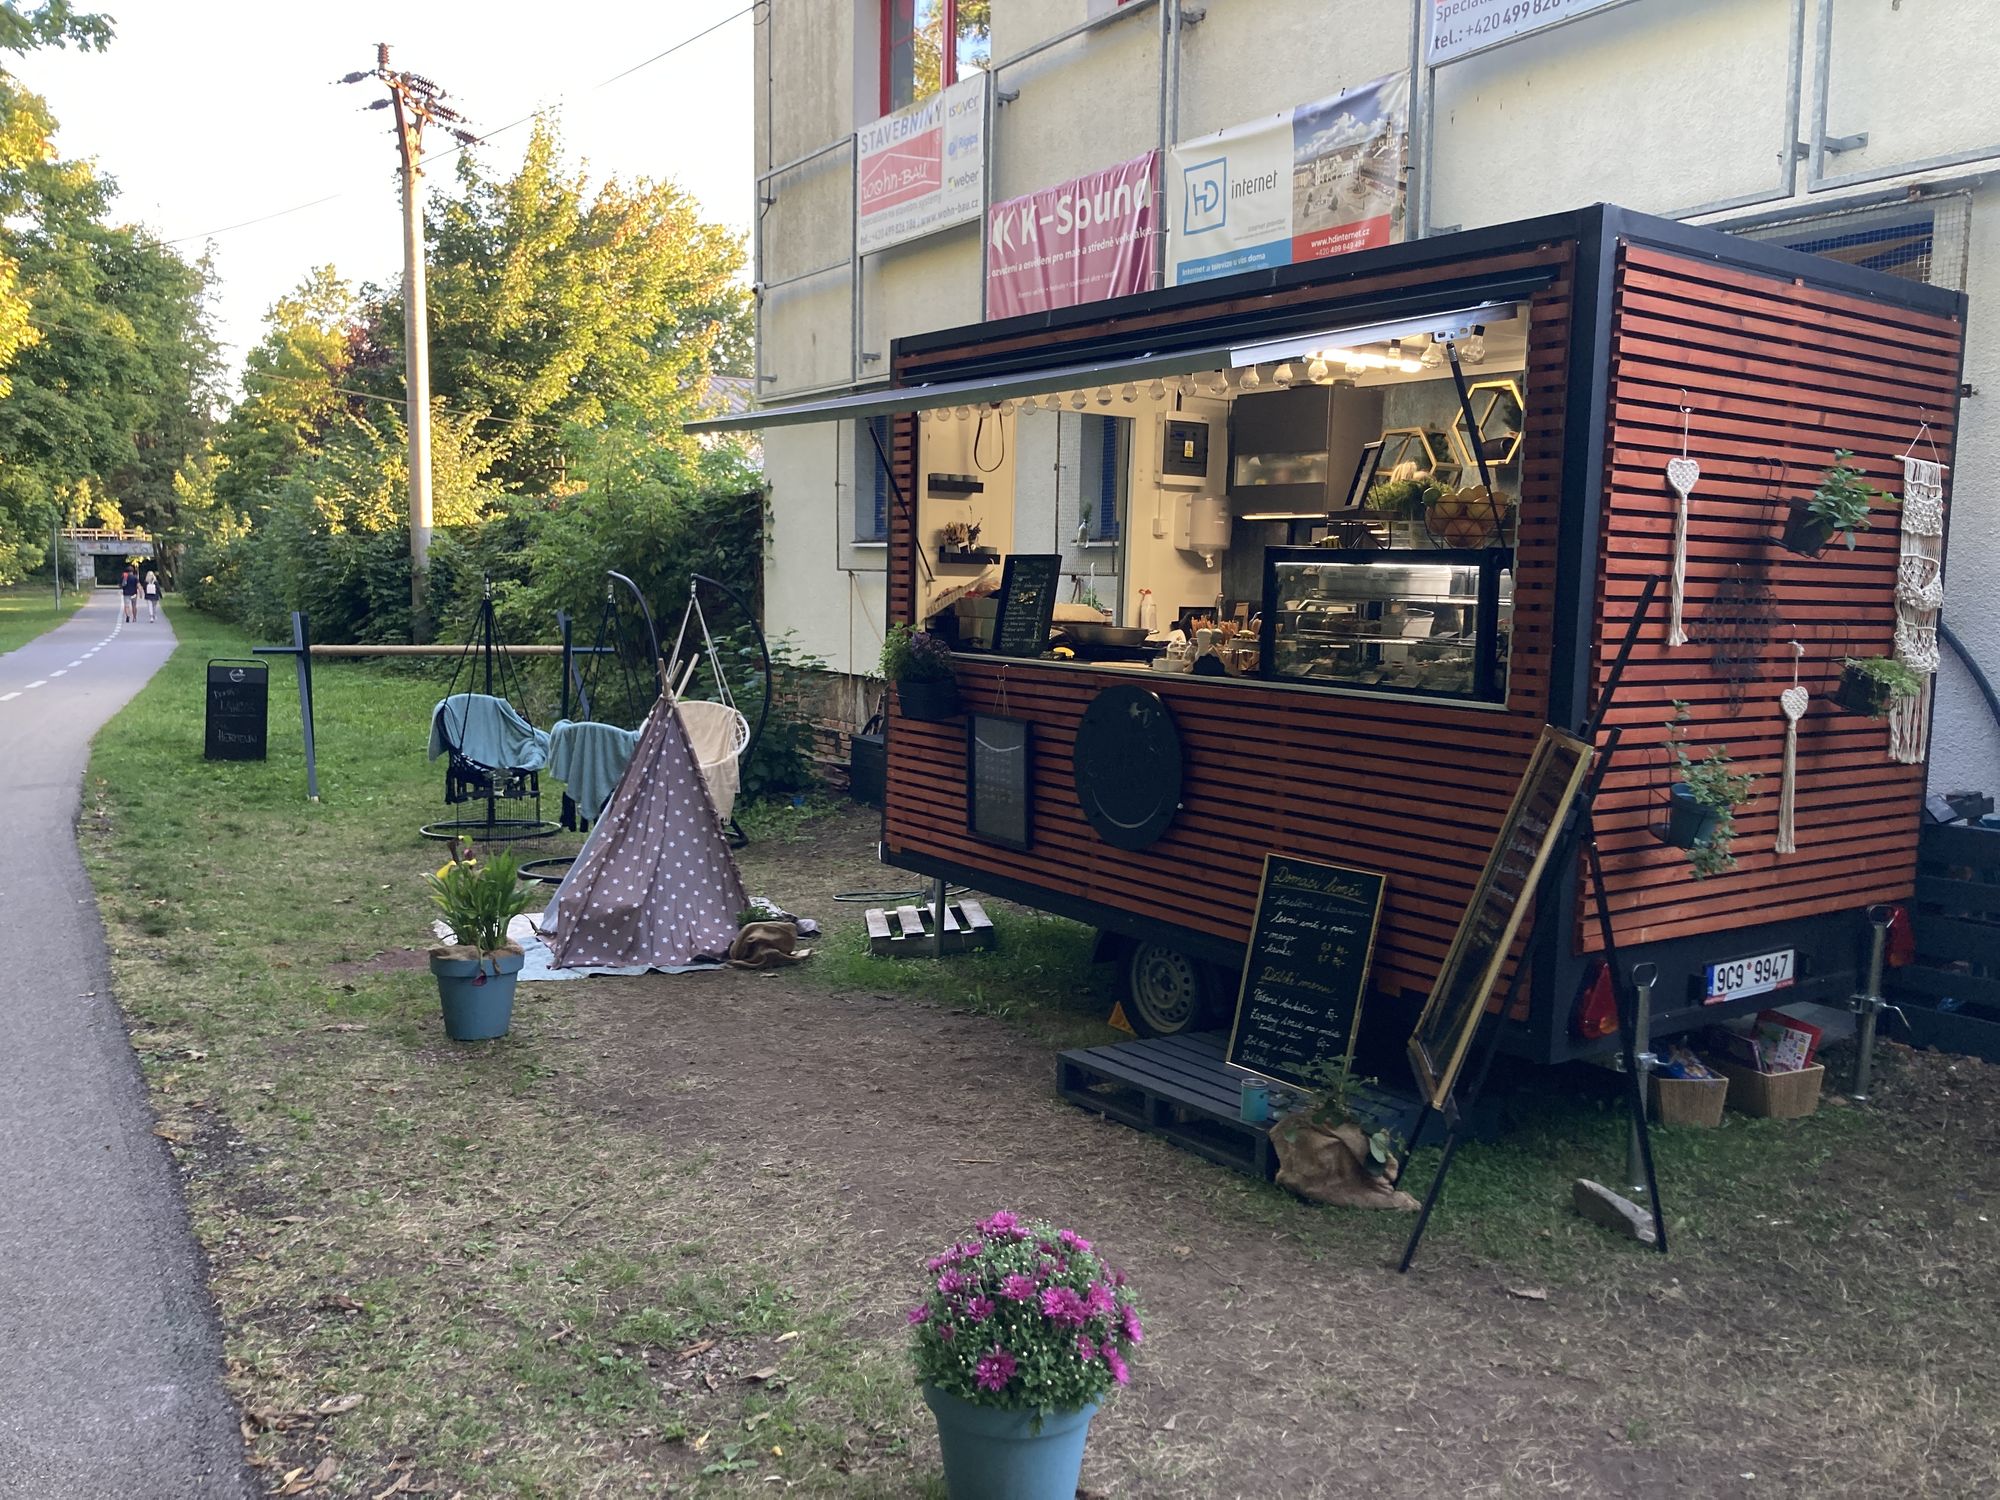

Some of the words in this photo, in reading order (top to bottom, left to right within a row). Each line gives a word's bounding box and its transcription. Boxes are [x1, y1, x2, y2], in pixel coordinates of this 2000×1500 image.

[1466, 12, 1500, 36] +420
[1503, 1, 1530, 24] 499
[861, 101, 942, 153] STAVEBNINY
[954, 170, 979, 188] weber
[1231, 169, 1278, 200] internet
[1311, 227, 1370, 248] www.hdinternet.cz
[1052, 251, 1064, 263] pro
[1082, 246, 1087, 254] a
[1248, 253, 1266, 263] doma
[1717, 964, 1743, 993] 9C9
[1755, 954, 1788, 984] 9947
